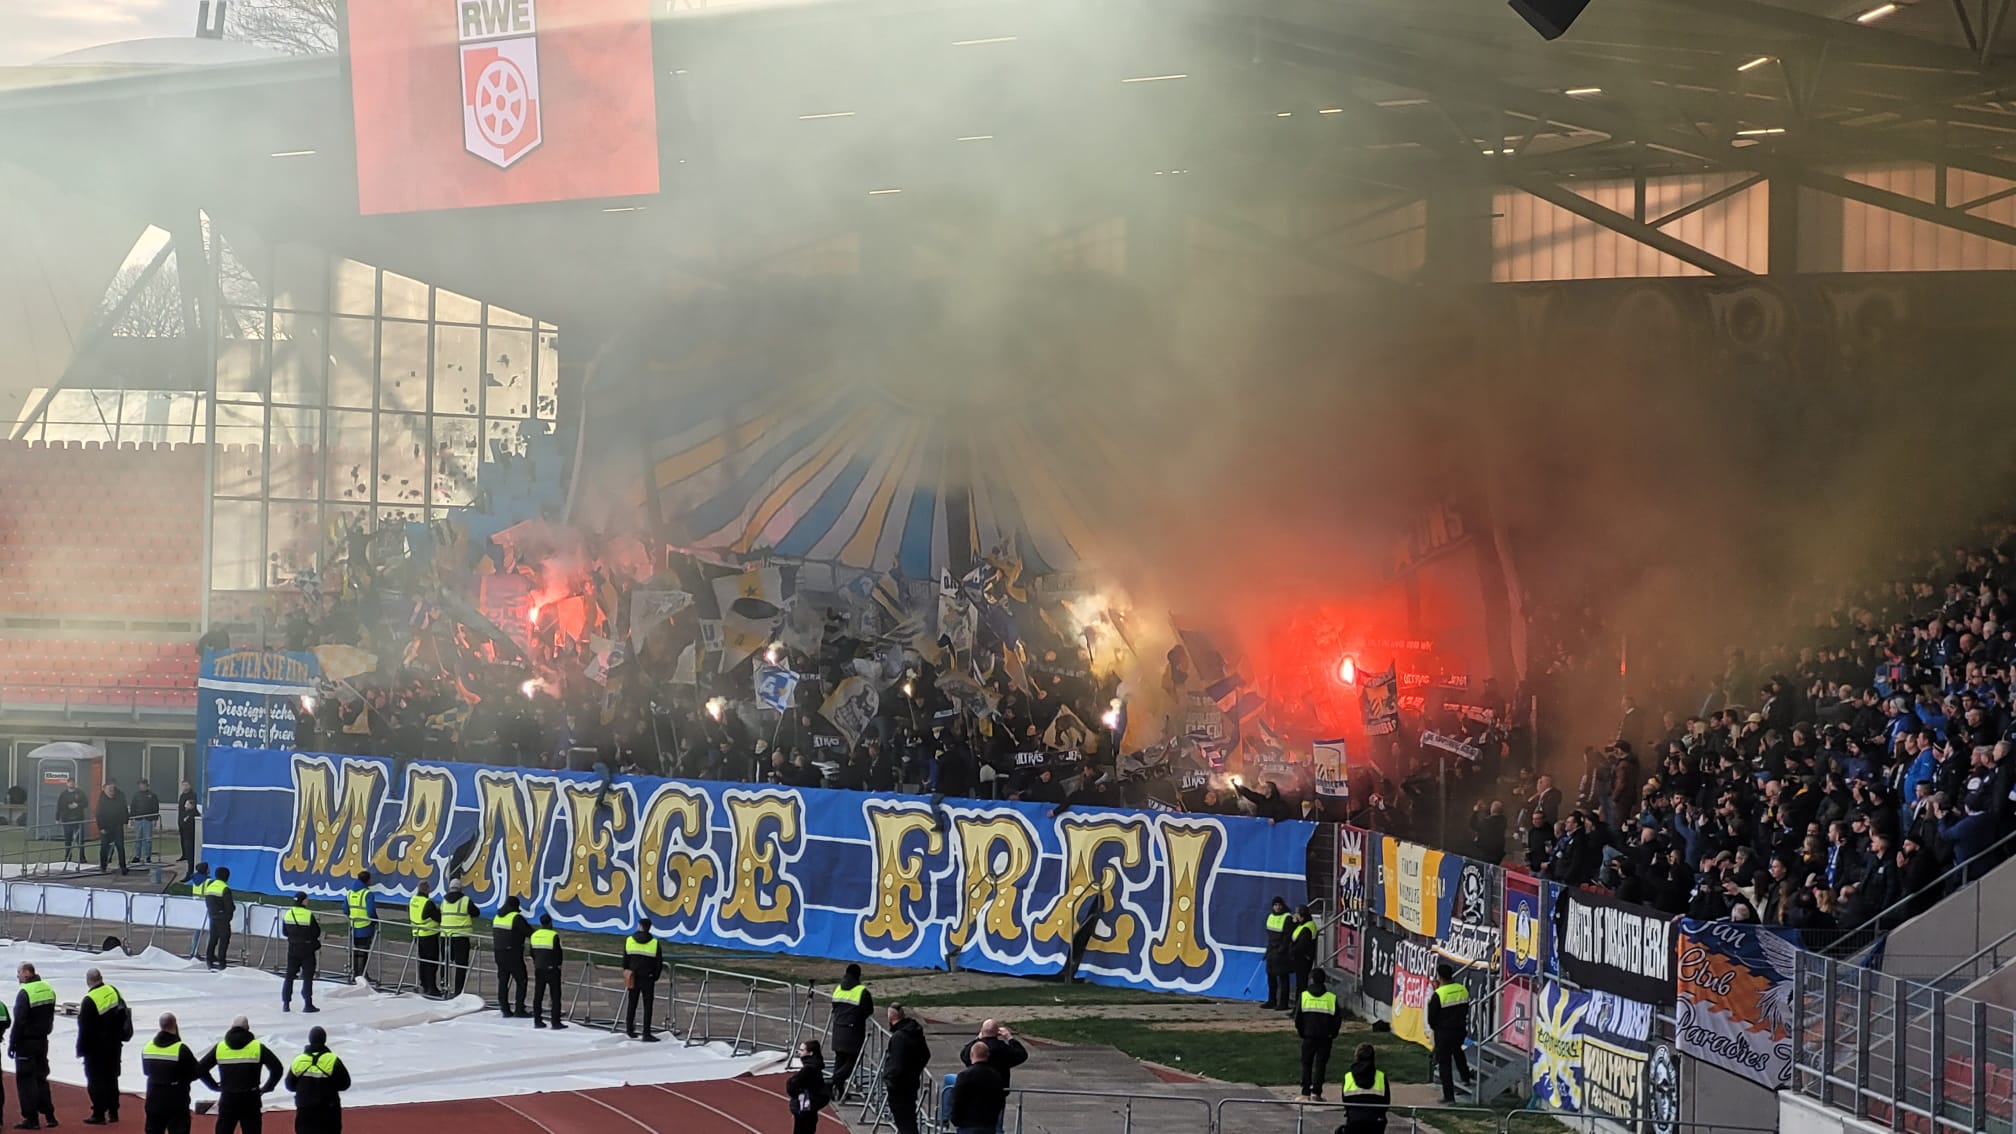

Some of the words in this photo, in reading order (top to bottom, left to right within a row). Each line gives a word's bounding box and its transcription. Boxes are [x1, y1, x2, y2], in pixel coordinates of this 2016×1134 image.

[461, 0, 532, 37] RWE
[216, 718, 258, 740] Farben
[279, 755, 804, 942] MANEGE
[858, 800, 1222, 984] FREI
[1564, 896, 1593, 963] MASTER
[1593, 906, 1605, 964] OF
[1604, 906, 1643, 975] DISASTER
[1643, 916, 1672, 982] GERA
[1682, 917, 1747, 949] Fan
[1678, 947, 1736, 997] Club
[1676, 990, 1771, 1073] Paradies
